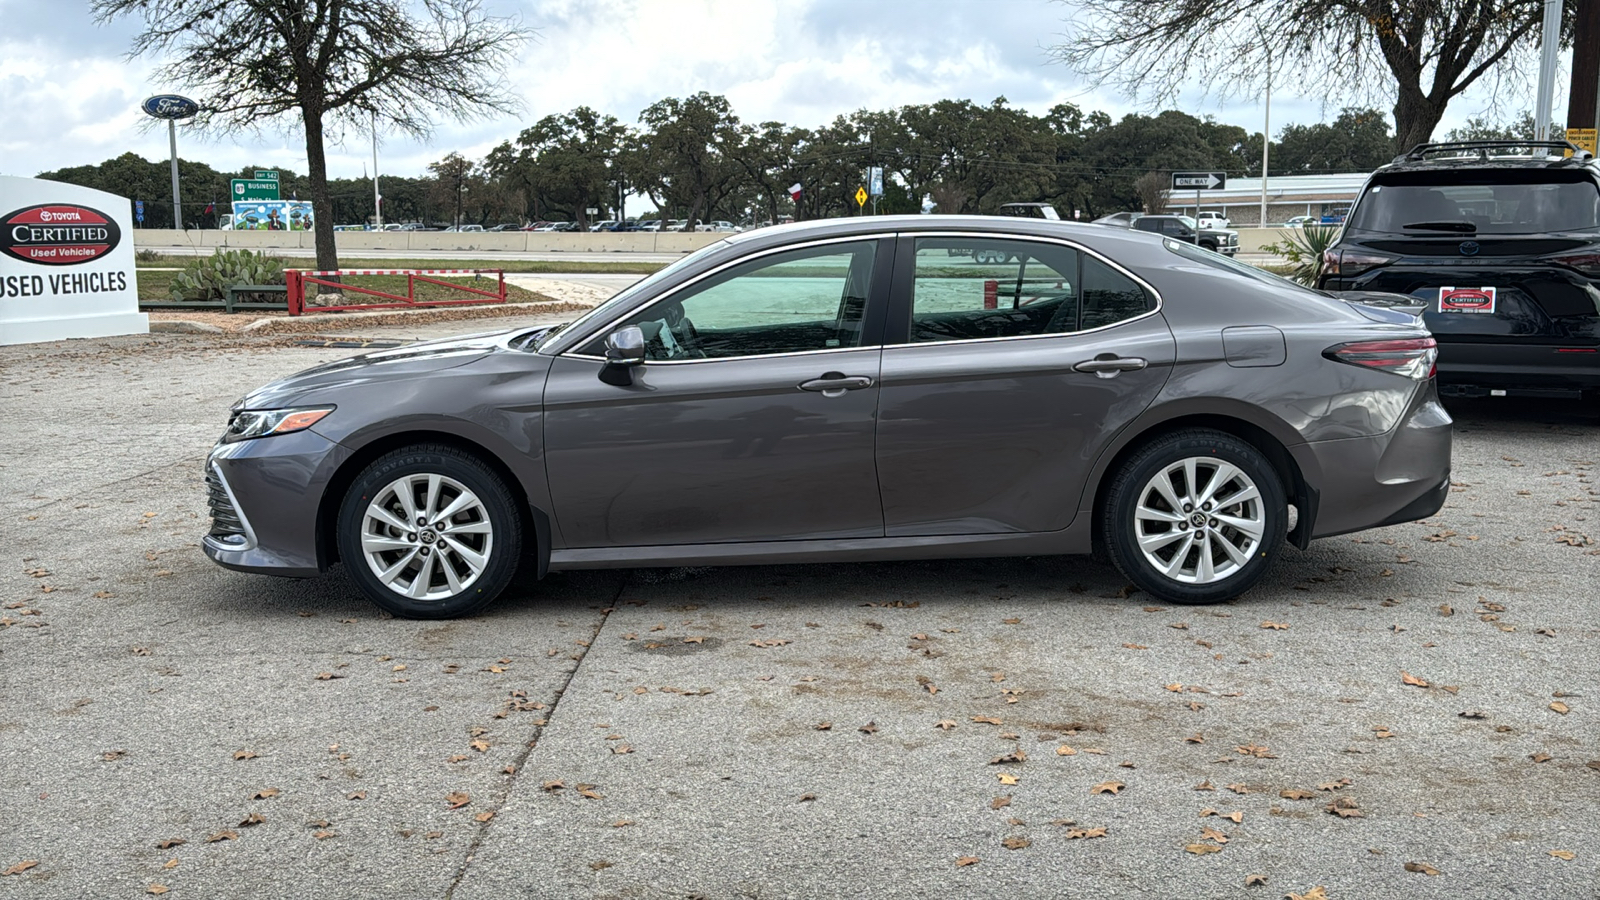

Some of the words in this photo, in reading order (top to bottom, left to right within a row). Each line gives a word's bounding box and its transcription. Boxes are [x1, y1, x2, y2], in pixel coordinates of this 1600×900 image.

[156, 98, 188, 113] Ford
[52, 212, 81, 221] TOYOTA
[11, 225, 108, 242] CERTIFIED
[30, 248, 56, 257] Used
[58, 248, 96, 256] Vehicles
[0, 275, 44, 298] SED
[48, 271, 126, 295] VEHICLES
[375, 456, 432, 478] ADVANTA
